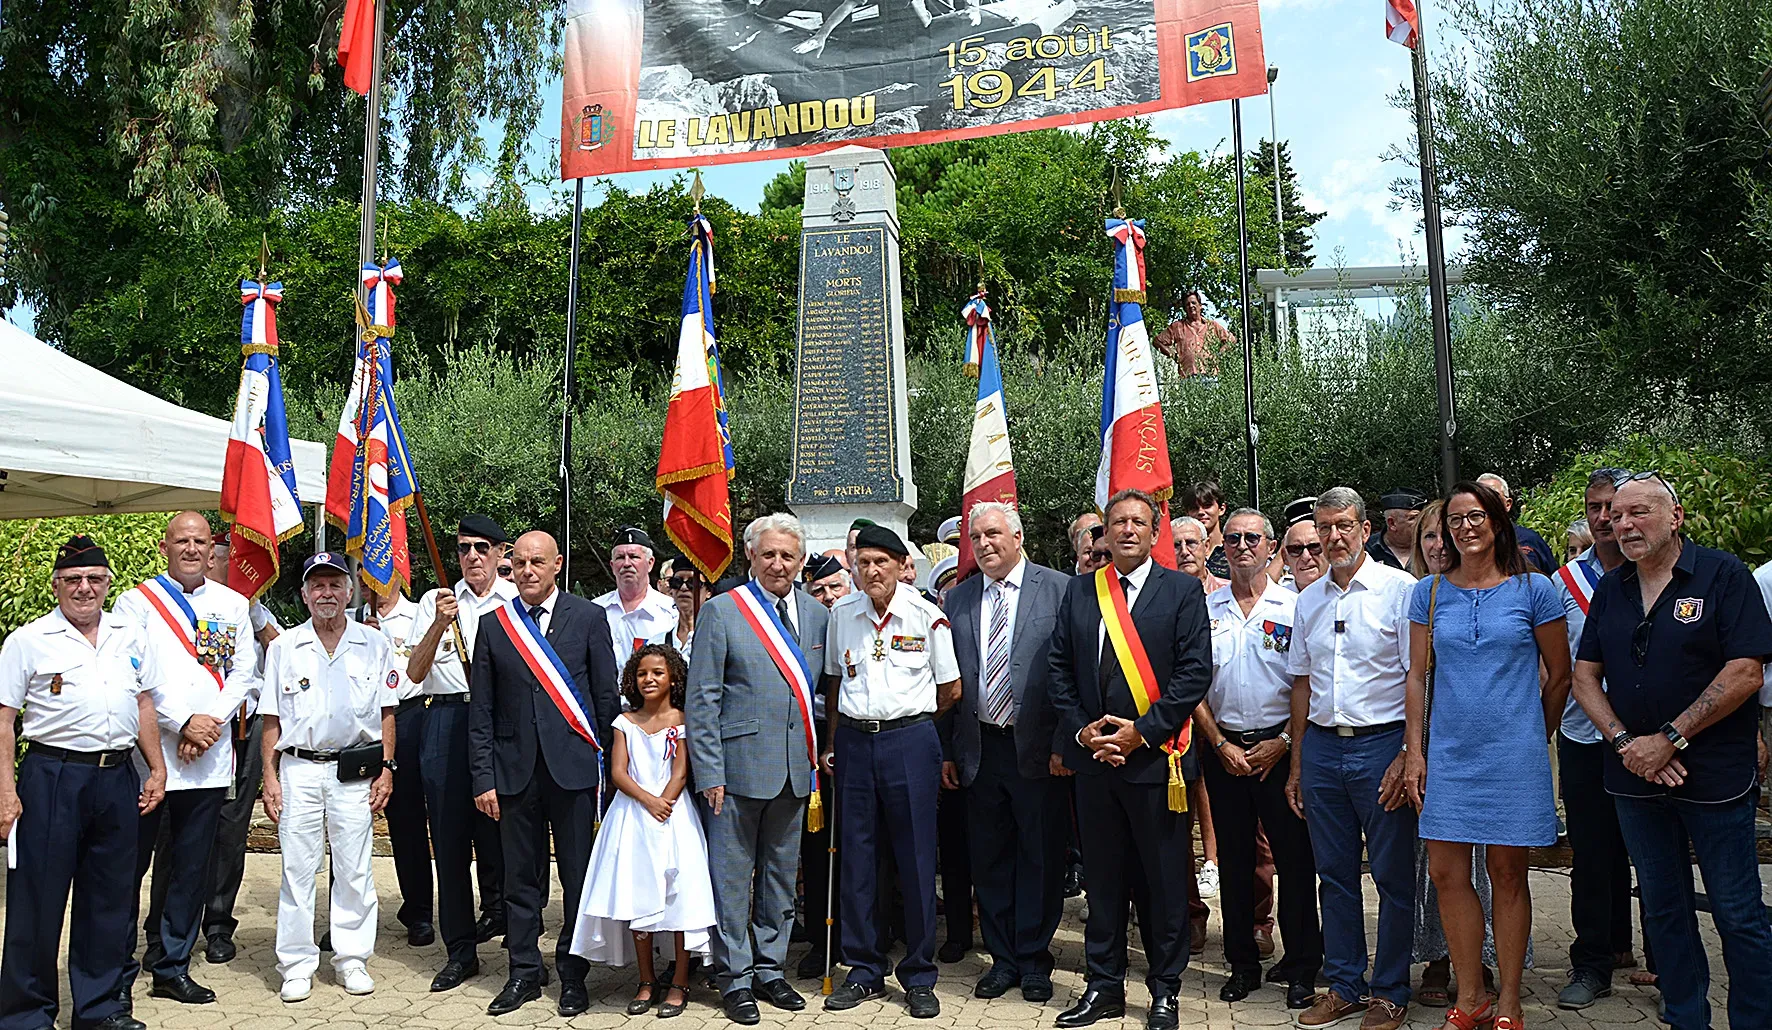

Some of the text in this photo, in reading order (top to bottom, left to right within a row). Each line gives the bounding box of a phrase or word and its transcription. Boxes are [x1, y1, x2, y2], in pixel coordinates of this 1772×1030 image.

[938, 23, 1114, 69] 15 août
[938, 57, 1114, 111] 1944
[638, 94, 877, 149] LE LAVANDOU
[809, 178, 881, 196] 1914 1918
[837, 234, 850, 244] LE
[814, 245, 873, 258] LAVANDOU
[826, 276, 862, 288] MORTS
[834, 485, 873, 497] PATRIA
